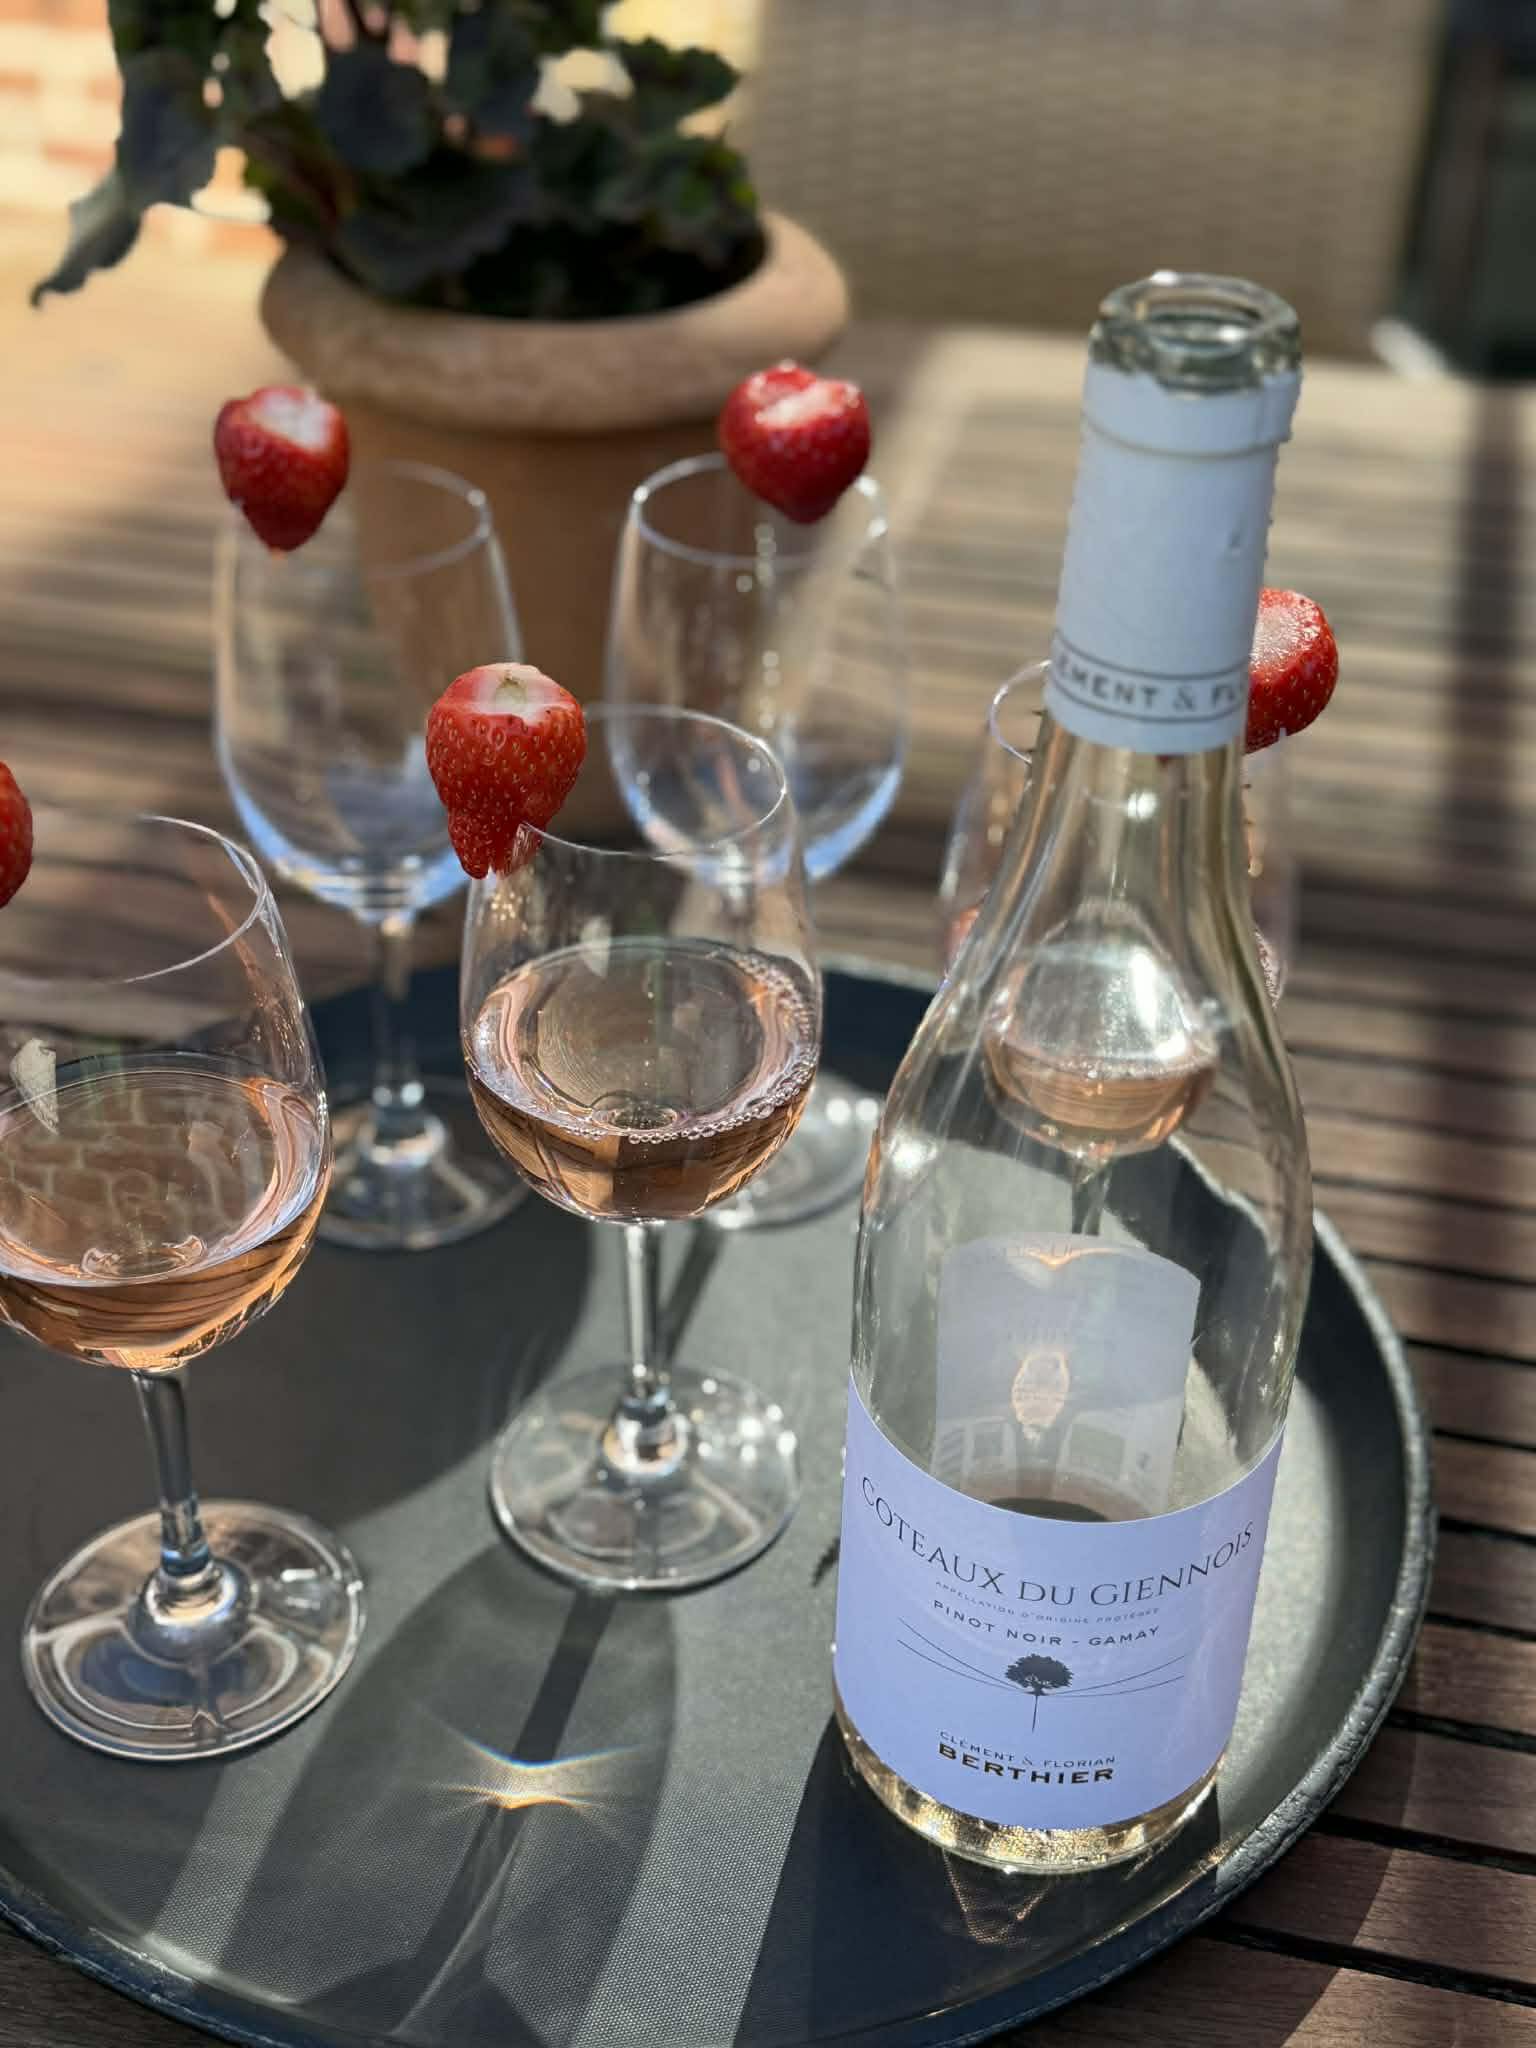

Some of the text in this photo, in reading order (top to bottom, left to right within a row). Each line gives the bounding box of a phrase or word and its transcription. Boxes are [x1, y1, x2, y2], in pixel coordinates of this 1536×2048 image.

[1172, 683, 1197, 711] &
[862, 1477, 1253, 1606] COTEAUX DU GIENNOIS
[934, 1599, 995, 1632] PINOT
[1007, 1628, 1062, 1645] NOIR
[1088, 1625, 1160, 1646] GAMAY
[939, 1742, 1114, 1784] BERTHIER
[1044, 1755, 1115, 1768] FLORIAN
